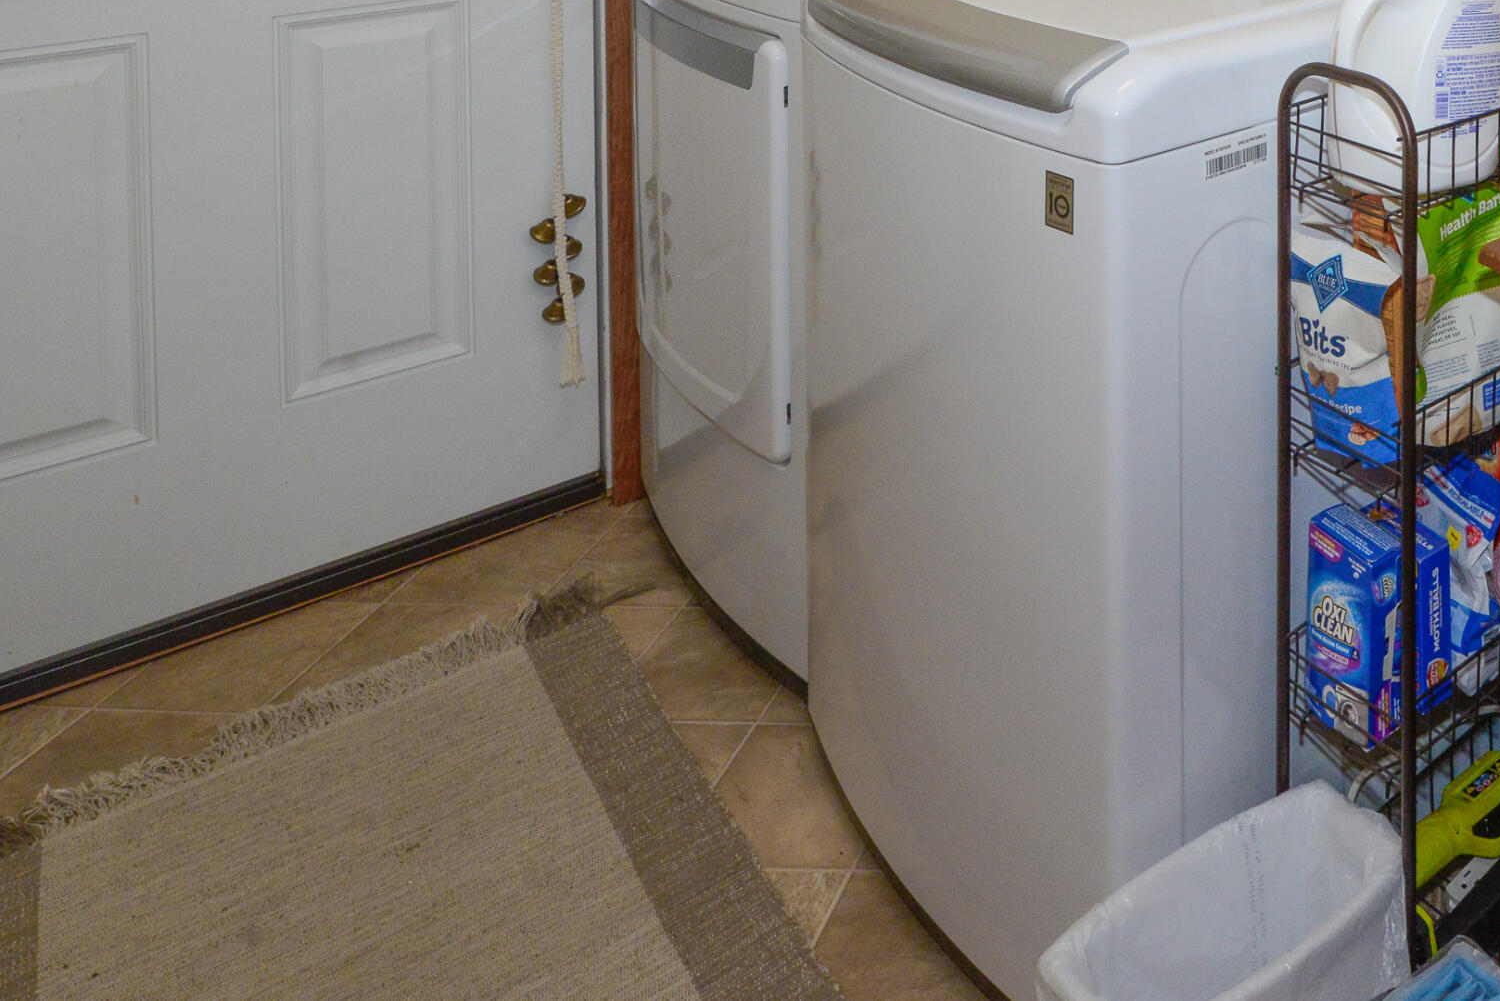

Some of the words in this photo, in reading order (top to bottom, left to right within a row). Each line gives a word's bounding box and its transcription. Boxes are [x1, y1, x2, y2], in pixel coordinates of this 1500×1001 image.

[1440, 207, 1478, 241] Health
[1317, 273, 1337, 289] BLUE
[1299, 316, 1346, 358] Bits
[1432, 567, 1440, 611] BALLS
[1313, 606, 1354, 644] CLEAN
[1322, 596, 1346, 624] OXI
